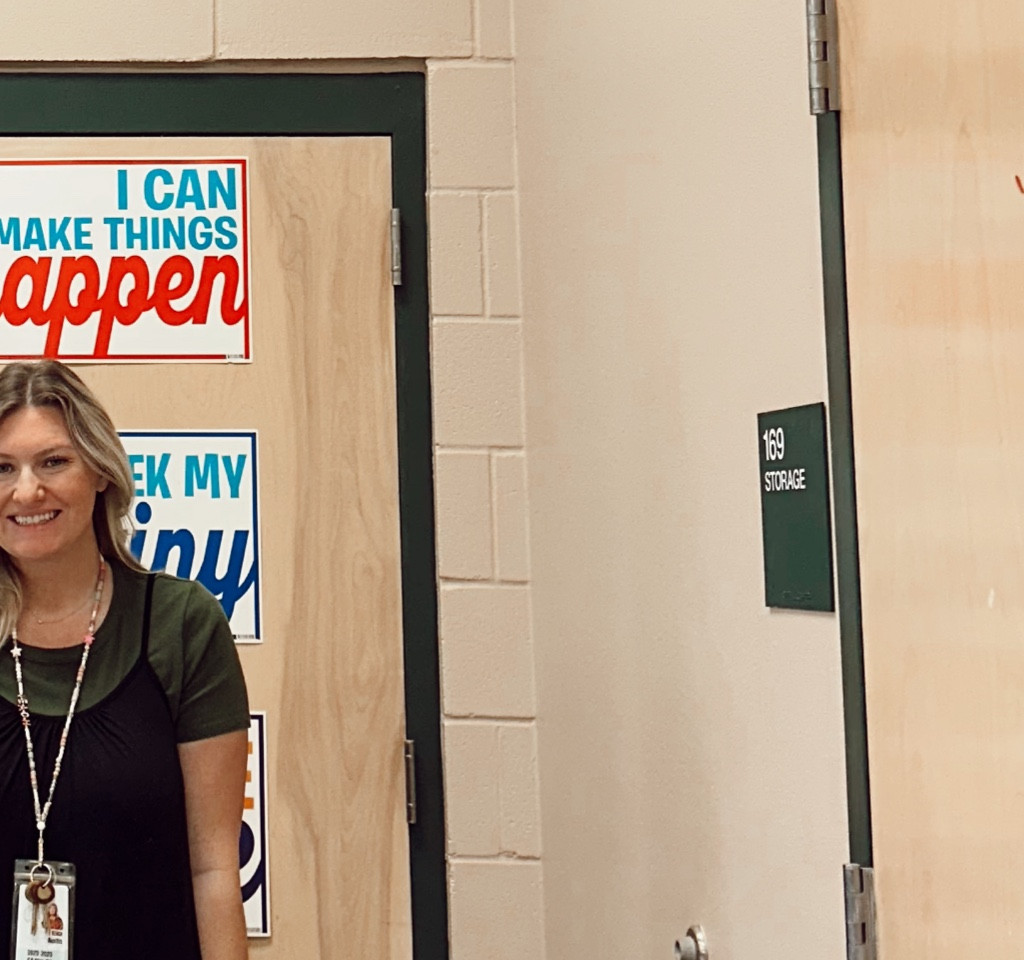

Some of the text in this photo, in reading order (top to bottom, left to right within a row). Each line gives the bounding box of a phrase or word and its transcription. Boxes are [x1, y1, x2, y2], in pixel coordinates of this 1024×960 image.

[117, 167, 237, 211] I CAN
[103, 215, 238, 251] THINGS
[762, 427, 785, 461] 169
[128, 453, 247, 498] EK MY
[764, 468, 806, 491] STORAGE
[130, 501, 255, 623] iny
